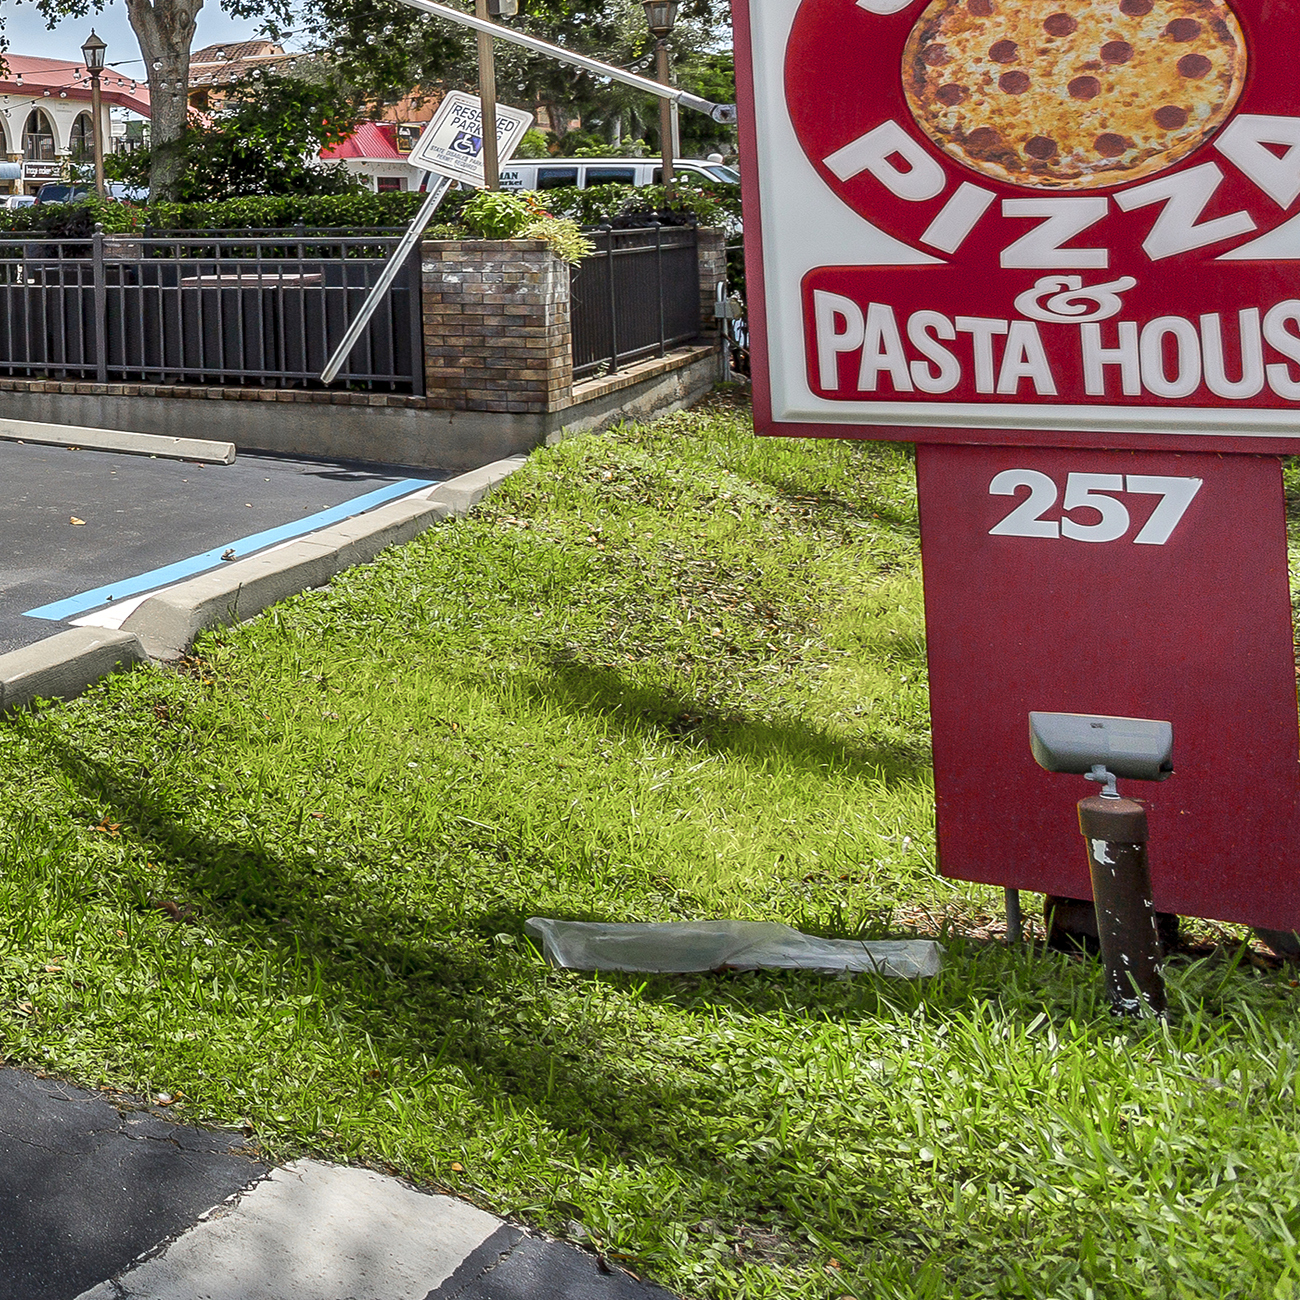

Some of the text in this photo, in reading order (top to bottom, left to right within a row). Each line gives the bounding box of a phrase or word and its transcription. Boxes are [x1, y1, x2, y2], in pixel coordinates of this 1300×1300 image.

[450, 116, 504, 141] PARKG
[451, 104, 515, 132] RESEED
[823, 113, 1300, 269] PIZZA
[1013, 274, 1137, 324] &
[813, 288, 1300, 401] PASTA HOUS
[988, 468, 1203, 546] 257
